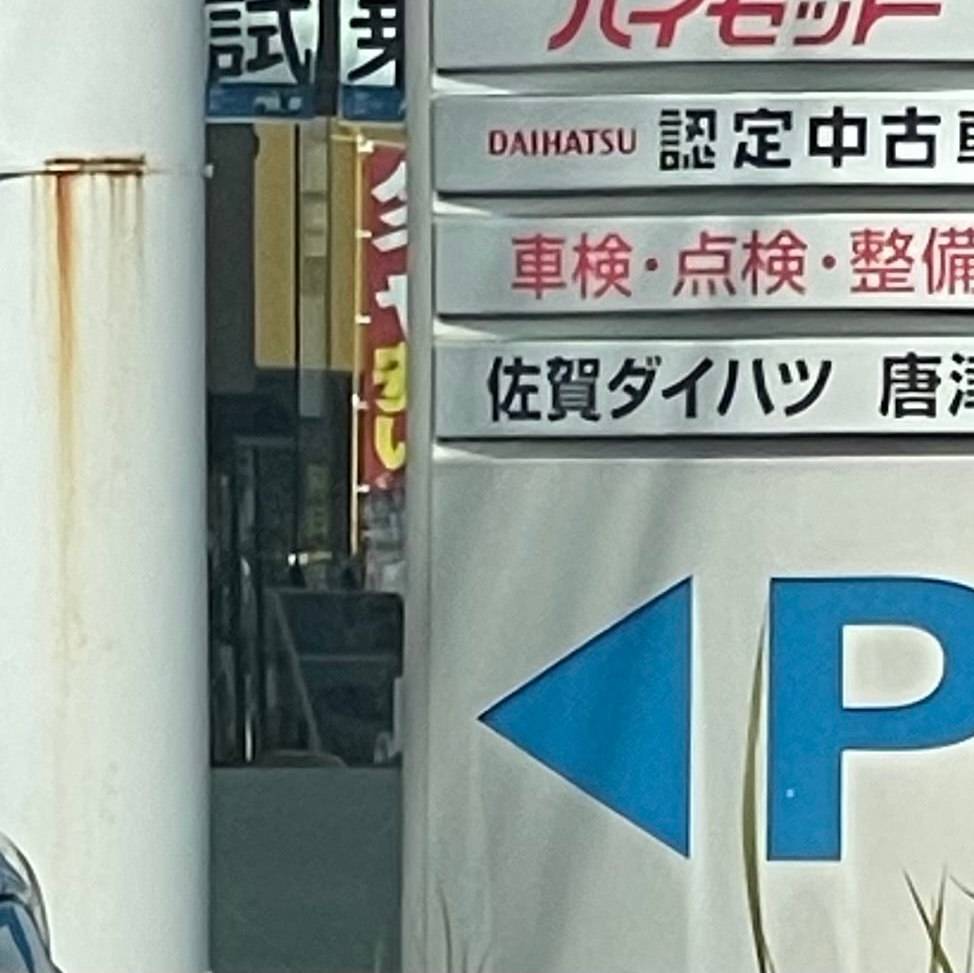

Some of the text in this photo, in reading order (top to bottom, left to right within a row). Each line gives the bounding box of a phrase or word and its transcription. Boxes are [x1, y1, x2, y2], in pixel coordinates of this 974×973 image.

[488, 128, 638, 157] DAIHATSU
[487, 355, 833, 423] 佐賀ダイハツ
